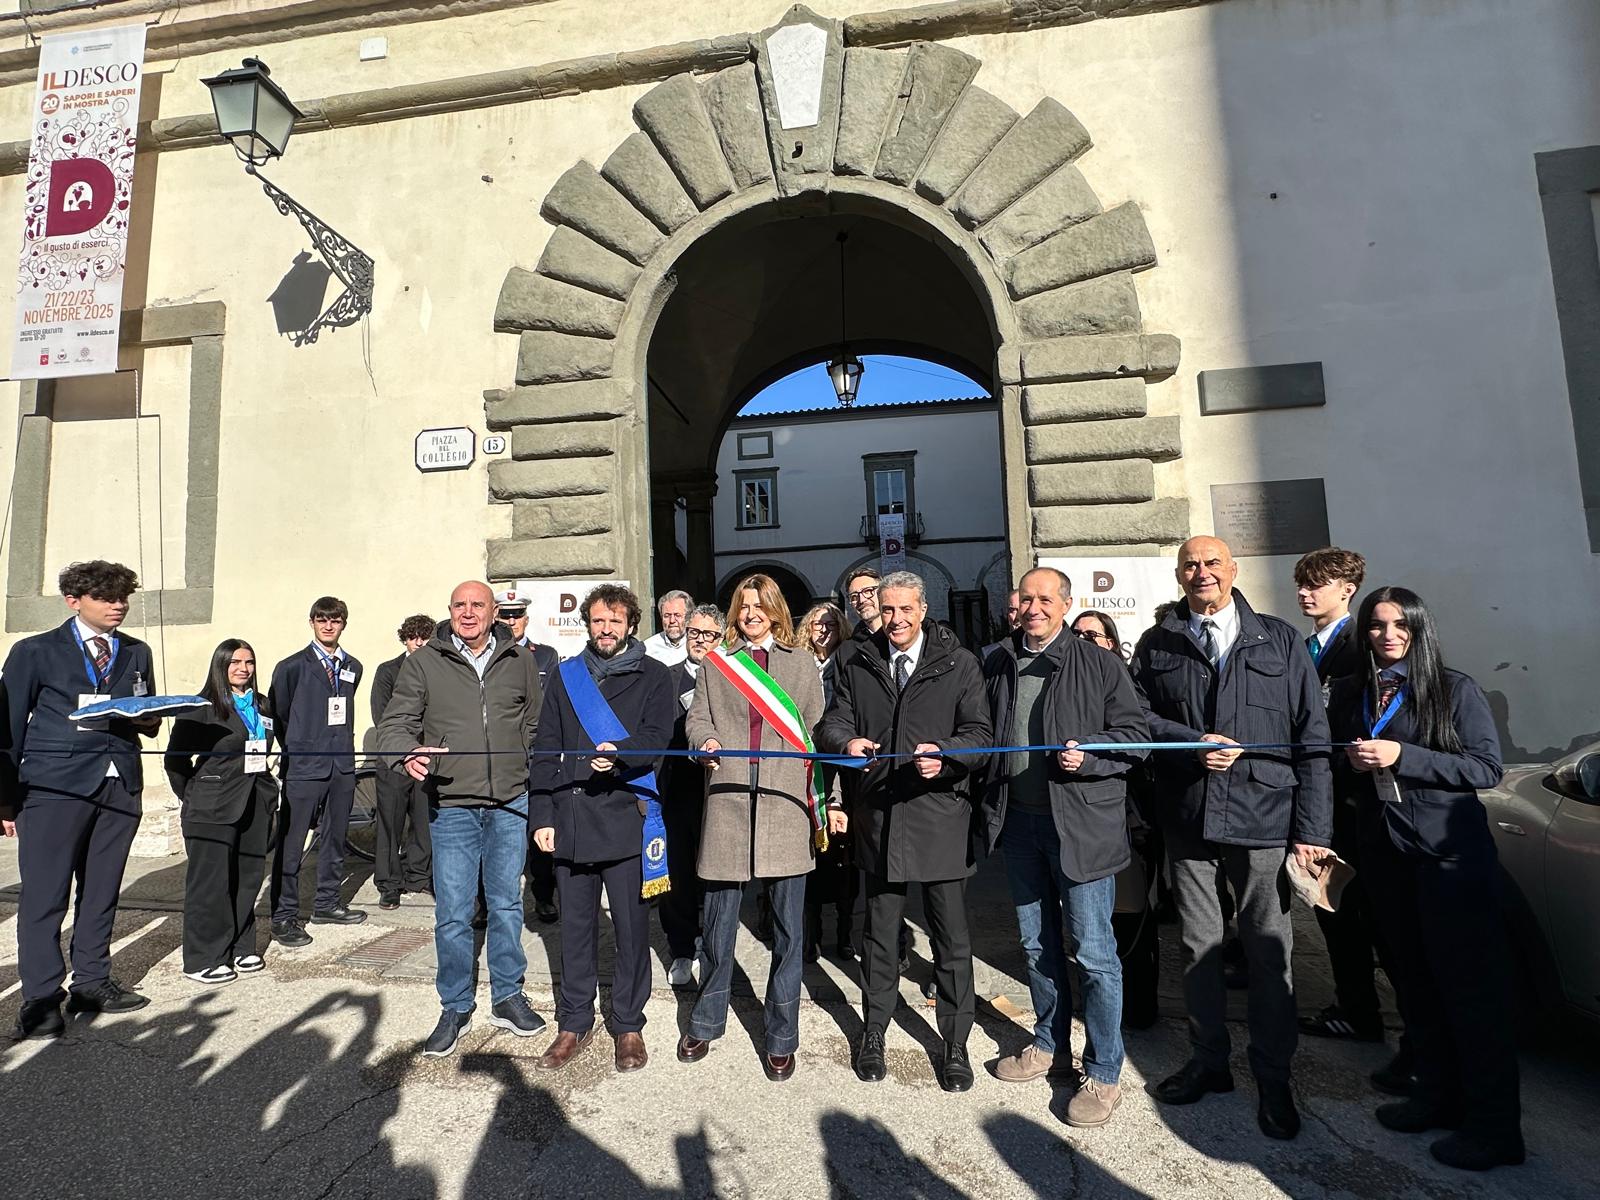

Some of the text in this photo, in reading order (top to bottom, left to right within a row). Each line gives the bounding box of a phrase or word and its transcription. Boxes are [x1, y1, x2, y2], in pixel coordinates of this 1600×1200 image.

[64, 93, 95, 102] SAPORI
[105, 88, 136, 97] SAPERI
[43, 98, 58, 108] 20
[74, 99, 109, 109] MOSTRA
[50, 242, 71, 253] gusto
[73, 241, 79, 250] di
[44, 290, 95, 308] 21/22/23
[24, 304, 114, 325] NOVEMBRE 2025
[431, 435, 458, 446] PIAZZA
[487, 439, 499, 451] 15
[422, 451, 467, 463] COLLEGIO
[548, 617, 584, 627] ILDESC
